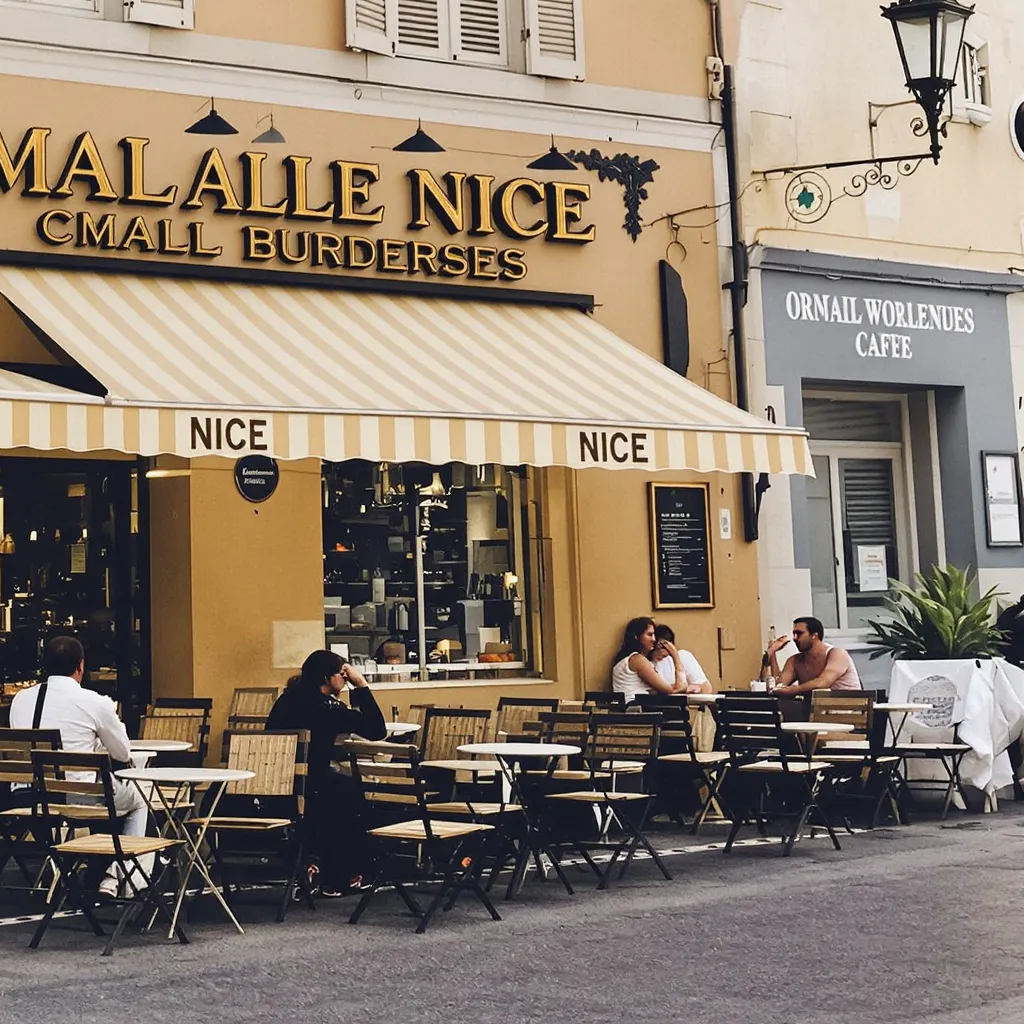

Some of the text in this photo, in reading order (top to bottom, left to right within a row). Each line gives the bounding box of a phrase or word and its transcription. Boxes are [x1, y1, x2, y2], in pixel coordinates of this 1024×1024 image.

[407, 168, 597, 243] NICE
[36, 209, 529, 280] CMALL BURDERSES
[190, 416, 268, 450] NICE
[579, 431, 649, 463] NICE
